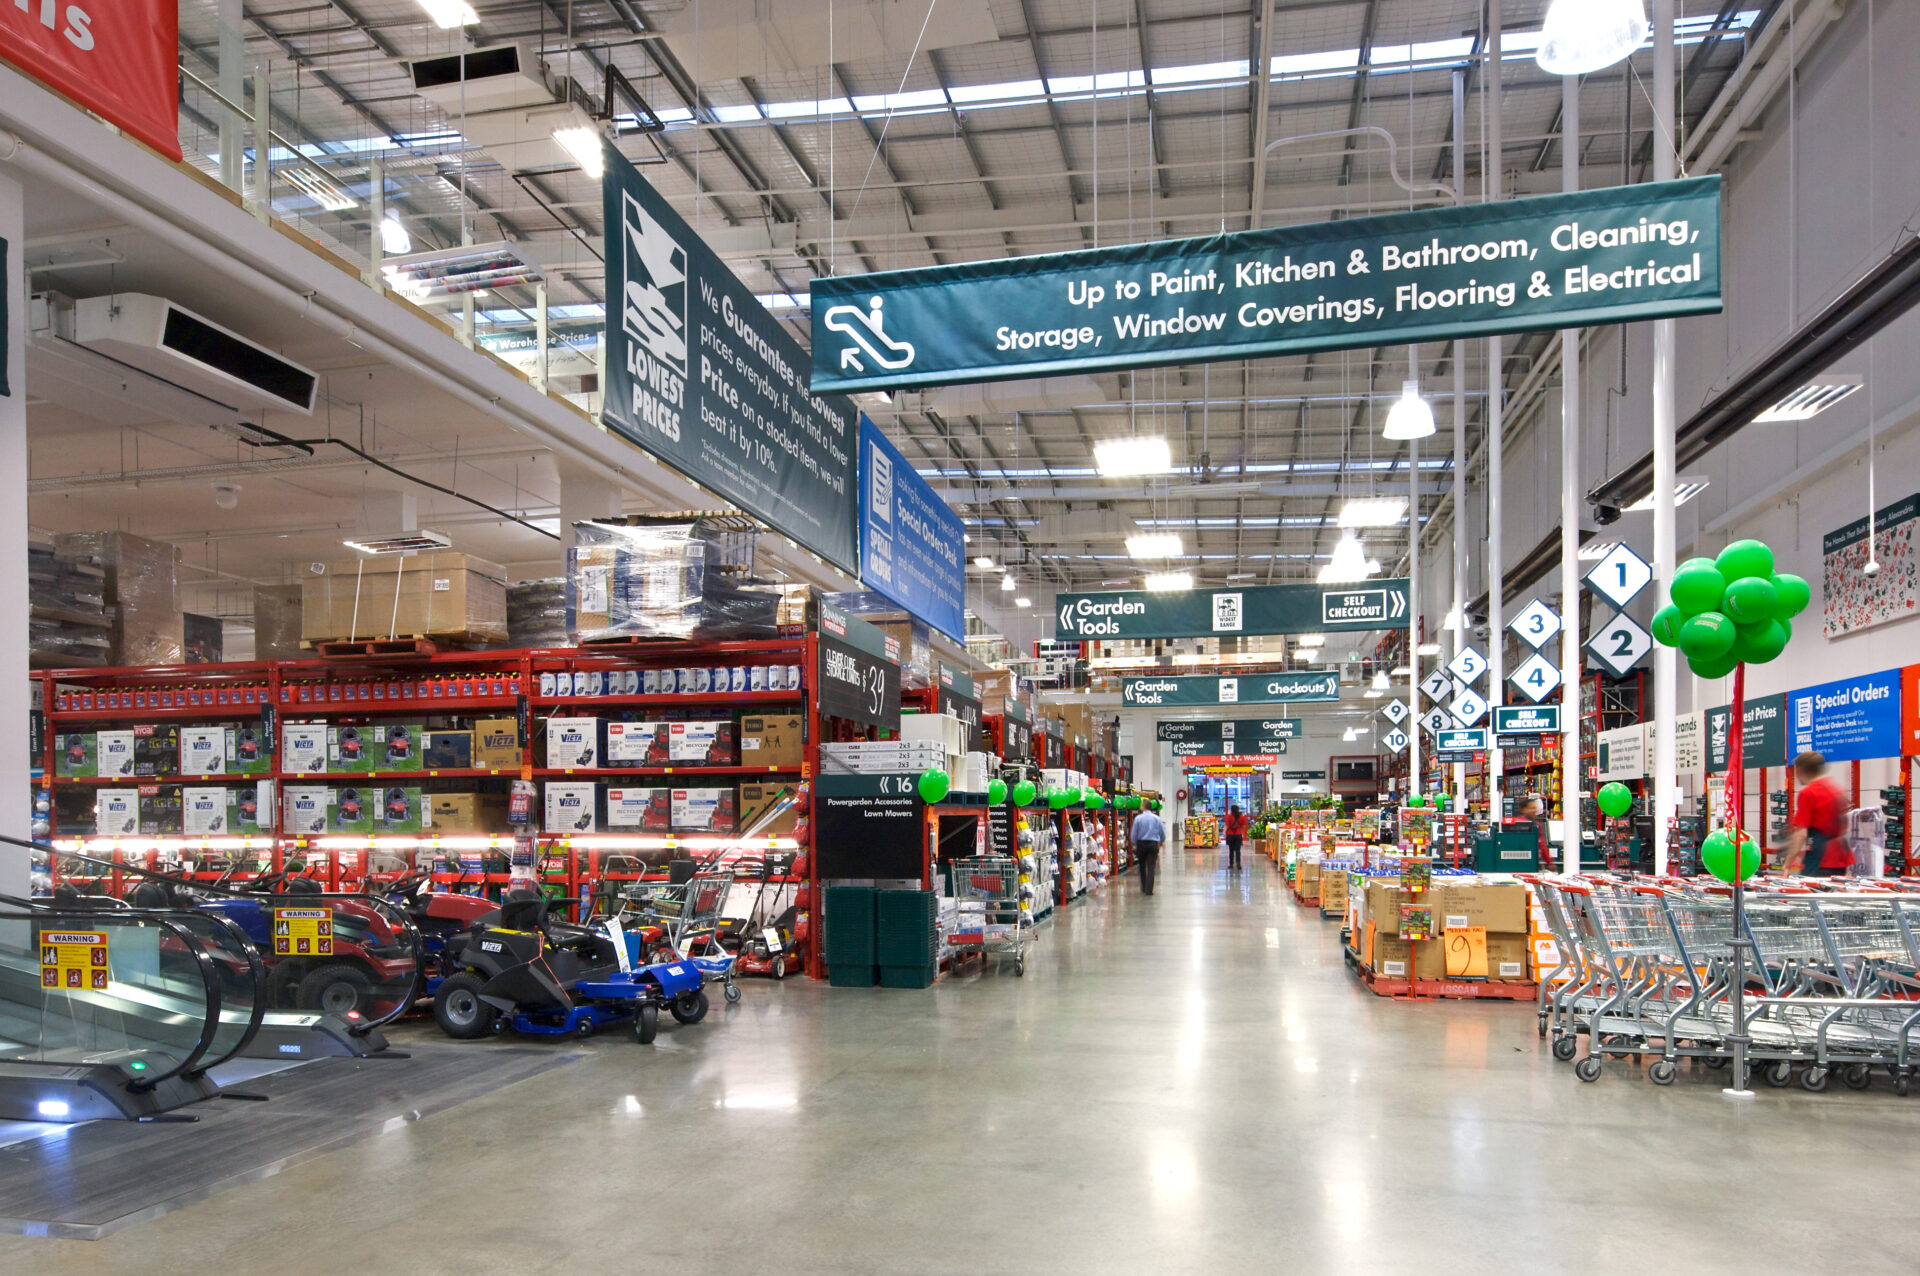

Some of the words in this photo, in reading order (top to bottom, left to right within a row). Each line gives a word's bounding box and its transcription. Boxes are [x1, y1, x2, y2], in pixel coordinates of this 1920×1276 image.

[1068, 280, 1105, 309] Up
[1116, 279, 1141, 301] to
[1150, 268, 1225, 297] Paint,
[1235, 255, 1336, 288] Kitchen
[1346, 248, 1370, 275] &
[1382, 237, 1538, 272] Bathroom,
[1550, 217, 1699, 252] Cleaning,
[996, 325, 1102, 351] Storage,
[1113, 307, 1227, 340] Window
[1237, 295, 1384, 328] Coverings,
[1396, 279, 1516, 312] Flooring
[1527, 271, 1552, 298] &
[1564, 253, 1700, 295] Electrical
[499, 336, 556, 350] Warehose
[700, 276, 718, 314] We
[722, 295, 794, 387] Guarantee
[796, 376, 809, 401] the
[627, 340, 684, 410] LOWEST
[700, 323, 734, 365] prices
[736, 355, 780, 408] everyday.
[782, 393, 789, 413] If
[791, 400, 805, 428] you
[807, 415, 821, 443] find
[823, 436, 828, 449] a
[830, 436, 848, 467] lower
[633, 382, 680, 443] PRICES
[701, 354, 739, 410] Price
[742, 402, 755, 423] on
[757, 414, 764, 430] a
[766, 421, 798, 459] stocked
[800, 443, 820, 479] item,
[820, 466, 832, 485] we
[833, 477, 845, 496] will
[701, 397, 727, 436] beat
[730, 419, 737, 444] it
[740, 426, 752, 459] by
[755, 439, 777, 474] 10%.
[897, 497, 921, 536] Special
[922, 522, 943, 555] Orders
[944, 542, 958, 568] Desk
[870, 529, 892, 562] SPECIAL
[870, 552, 892, 583] ORDERS
[1615, 563, 1626, 587] 1
[1076, 597, 1145, 617] Garden
[1343, 596, 1366, 607] SELF
[1328, 606, 1381, 618] CHECKOUT
[1076, 618, 1120, 635] Tools
[1529, 614, 1544, 634] 3
[1610, 630, 1633, 656] 2
[1463, 658, 1474, 673] 5
[1528, 668, 1545, 687] 4
[1135, 680, 1177, 692] Garden
[1267, 682, 1325, 694] Checkouts
[1432, 680, 1443, 693] 7
[1135, 692, 1162, 704] Tools
[1815, 688, 1849, 713] Special
[1851, 683, 1889, 704] Orders
[1391, 705, 1400, 718] 9
[1462, 700, 1475, 715] 6
[1755, 705, 1777, 720] Prices
[1165, 723, 1194, 732] Garden
[1262, 721, 1293, 731] Garden
[1431, 715, 1442, 729] 8
[1506, 718, 1550, 728] CHECKOUT
[1816, 723, 1830, 732] Special
[1831, 721, 1846, 729] Orders
[1846, 719, 1857, 727] Desk
[134, 726, 153, 735] RYOBI
[1165, 731, 1183, 740] Care
[1273, 729, 1293, 737] Care
[484, 734, 515, 748] VICTA
[561, 733, 582, 742] VICTA
[1389, 735, 1405, 746] 10
[108, 744, 126, 753] VICTA
[193, 741, 211, 750] VICTA
[294, 740, 314, 748] VICTA
[1178, 741, 1204, 749] Outdoor
[1258, 740, 1279, 748] Indoor
[1260, 746, 1279, 754] Plants
[1178, 748, 1197, 756] Living
[1243, 754, 1274, 763] Workshop
[140, 786, 159, 794] RYOBI
[896, 777, 913, 793] 16
[108, 802, 126, 811] VICTA
[195, 801, 213, 810] VICTA
[295, 801, 315, 809] VICTA
[559, 797, 581, 807] VICTA
[827, 798, 873, 807] Powergarden
[874, 797, 913, 806] Accessories
[864, 810, 883, 818] Lawn
[884, 809, 913, 818] Mowers
[54, 934, 95, 943] WARNING
[481, 941, 503, 953] VICTA
